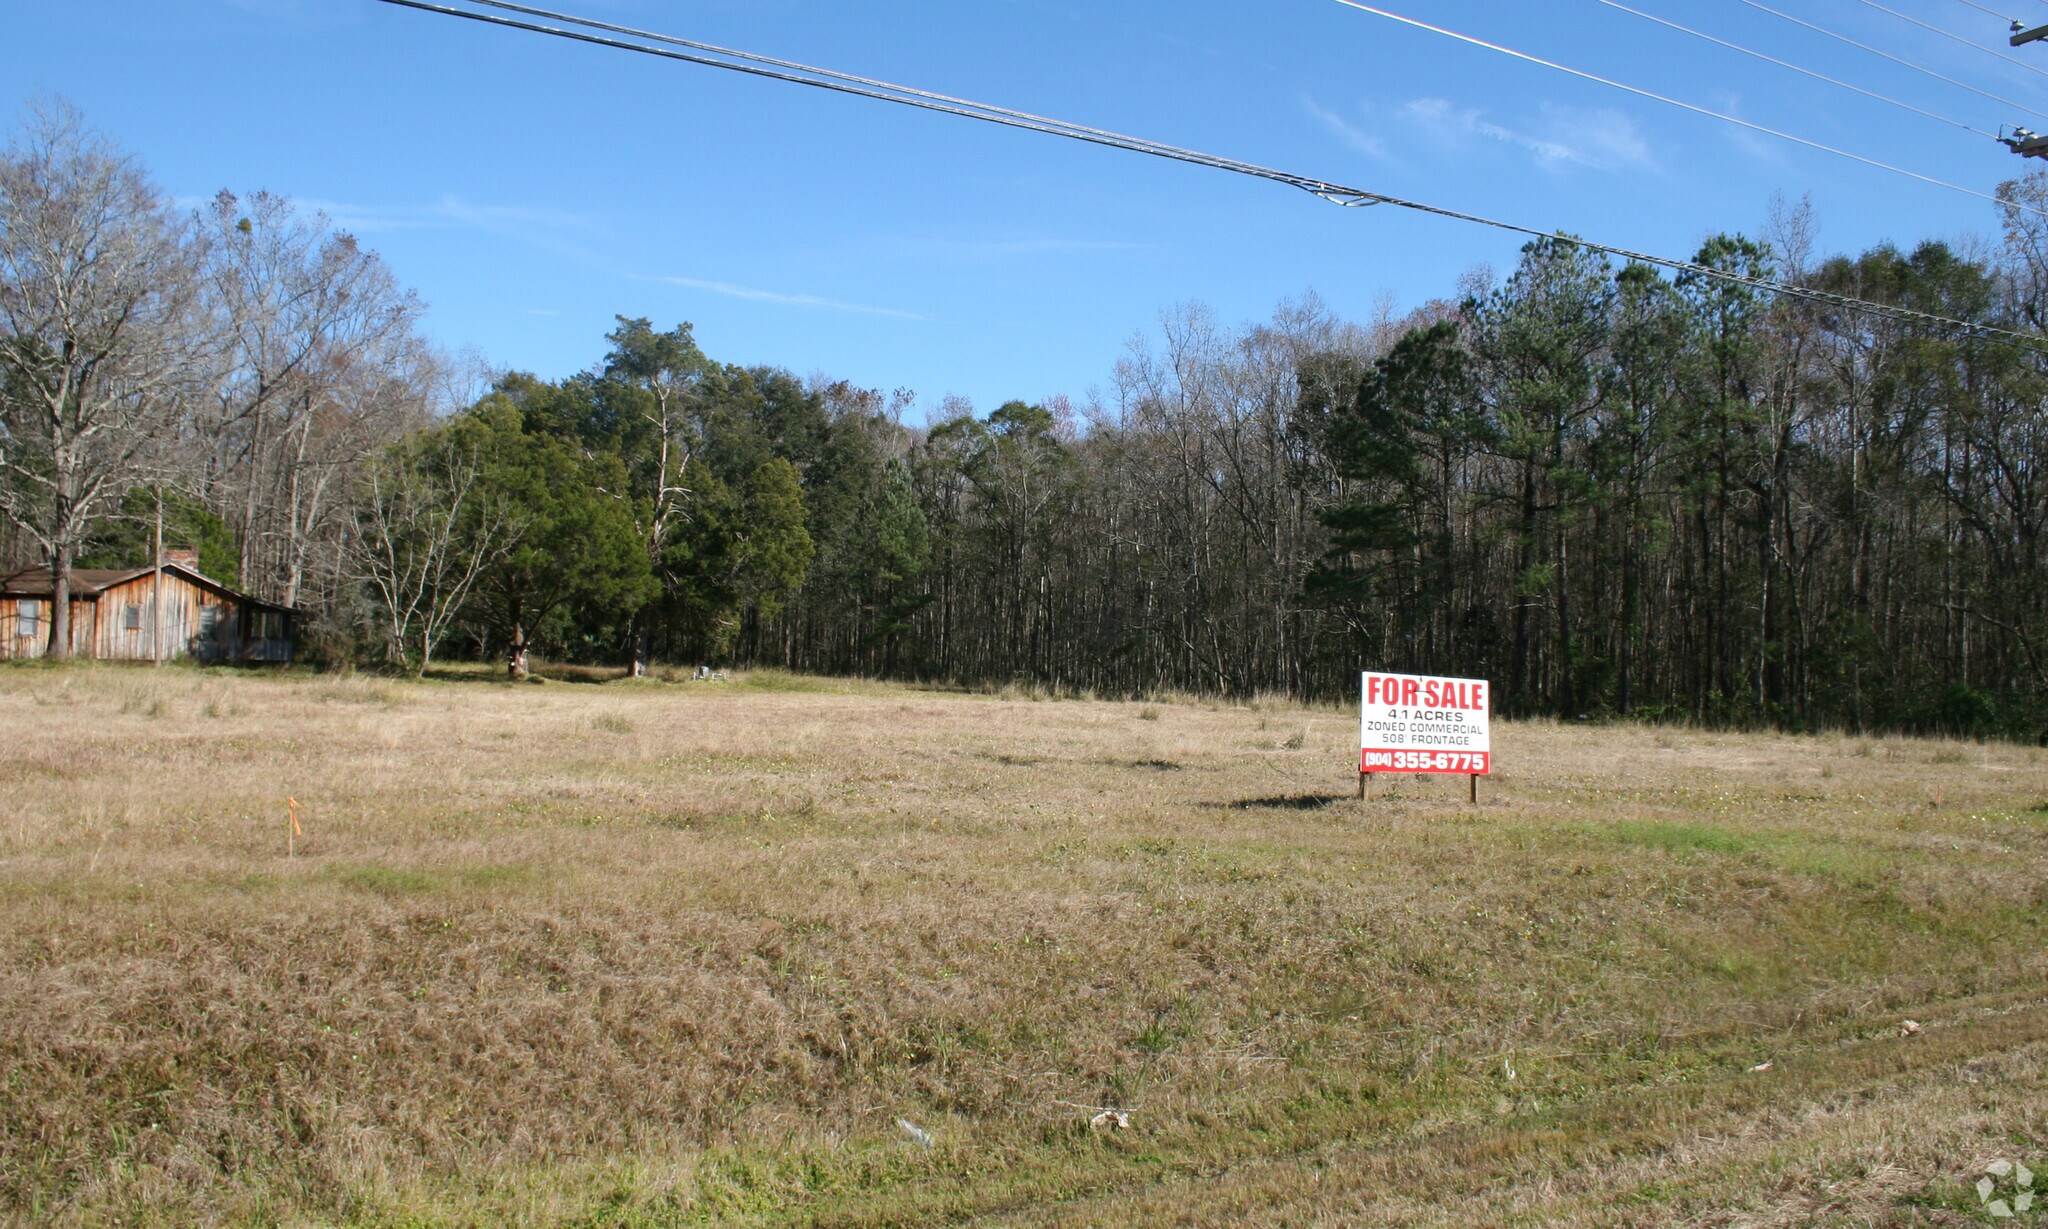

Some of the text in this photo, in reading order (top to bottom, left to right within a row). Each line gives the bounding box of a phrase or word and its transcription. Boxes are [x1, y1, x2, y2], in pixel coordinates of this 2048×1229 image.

[1368, 677, 1483, 710] FOR SALE
[1388, 709, 1464, 722] 4.1 ACRES
[1367, 721, 1483, 735] ZONED COMMERCIAL
[1411, 734, 1470, 746] FRONTAGE
[1365, 751, 1484, 770] (904) 355-6775
